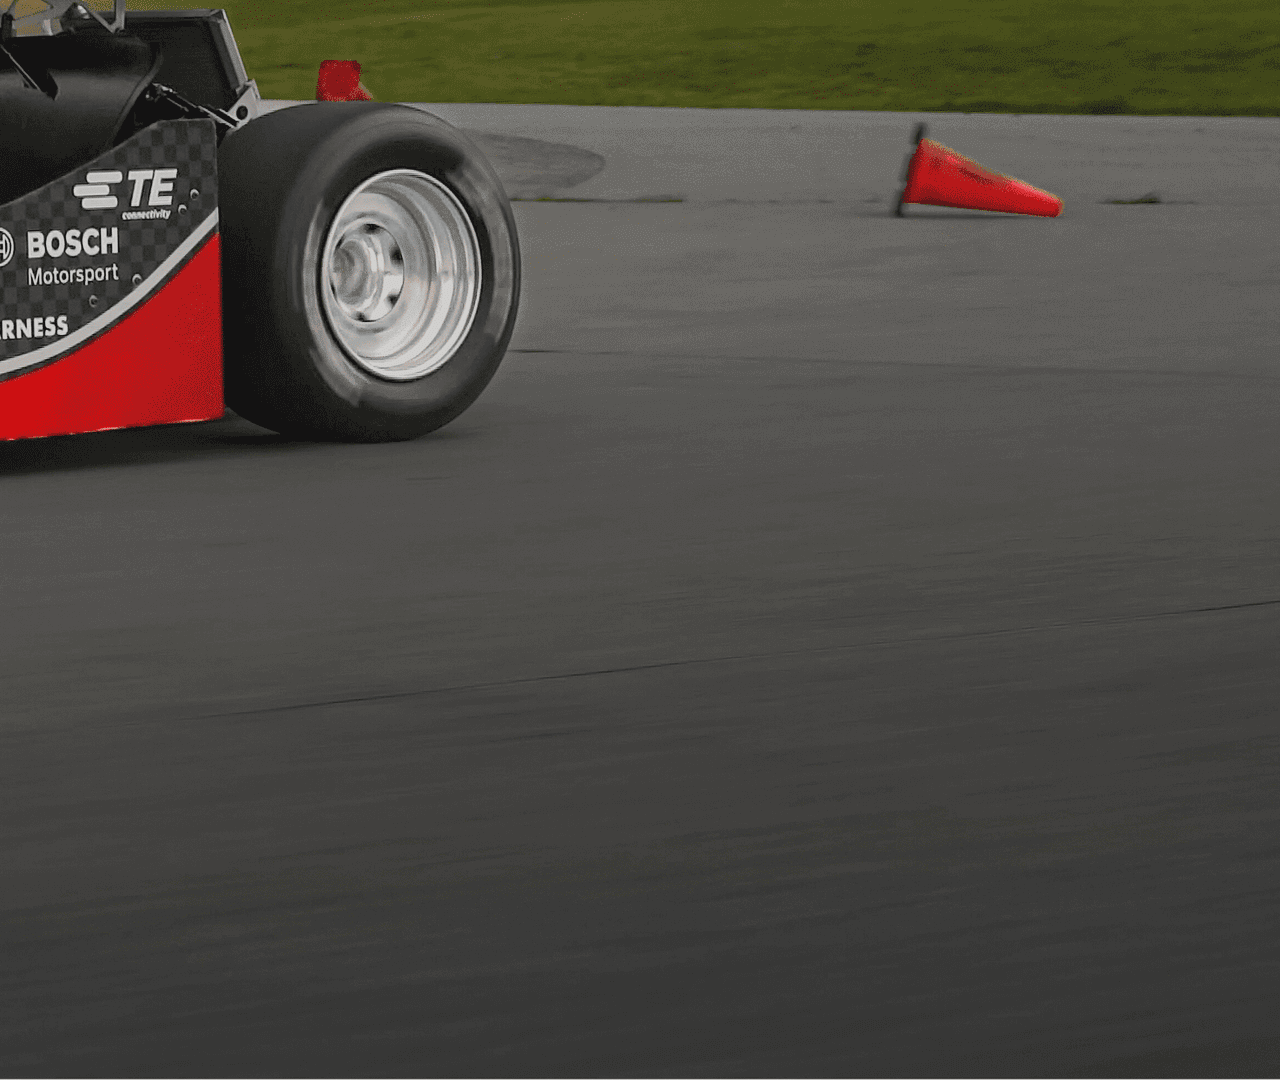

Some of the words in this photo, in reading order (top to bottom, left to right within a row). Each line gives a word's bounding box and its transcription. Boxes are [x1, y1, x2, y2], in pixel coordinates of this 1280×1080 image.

[128, 168, 178, 207] TE
[122, 208, 171, 220] connectivity
[27, 227, 119, 259] BOSCH
[28, 263, 119, 286] Motorsport
